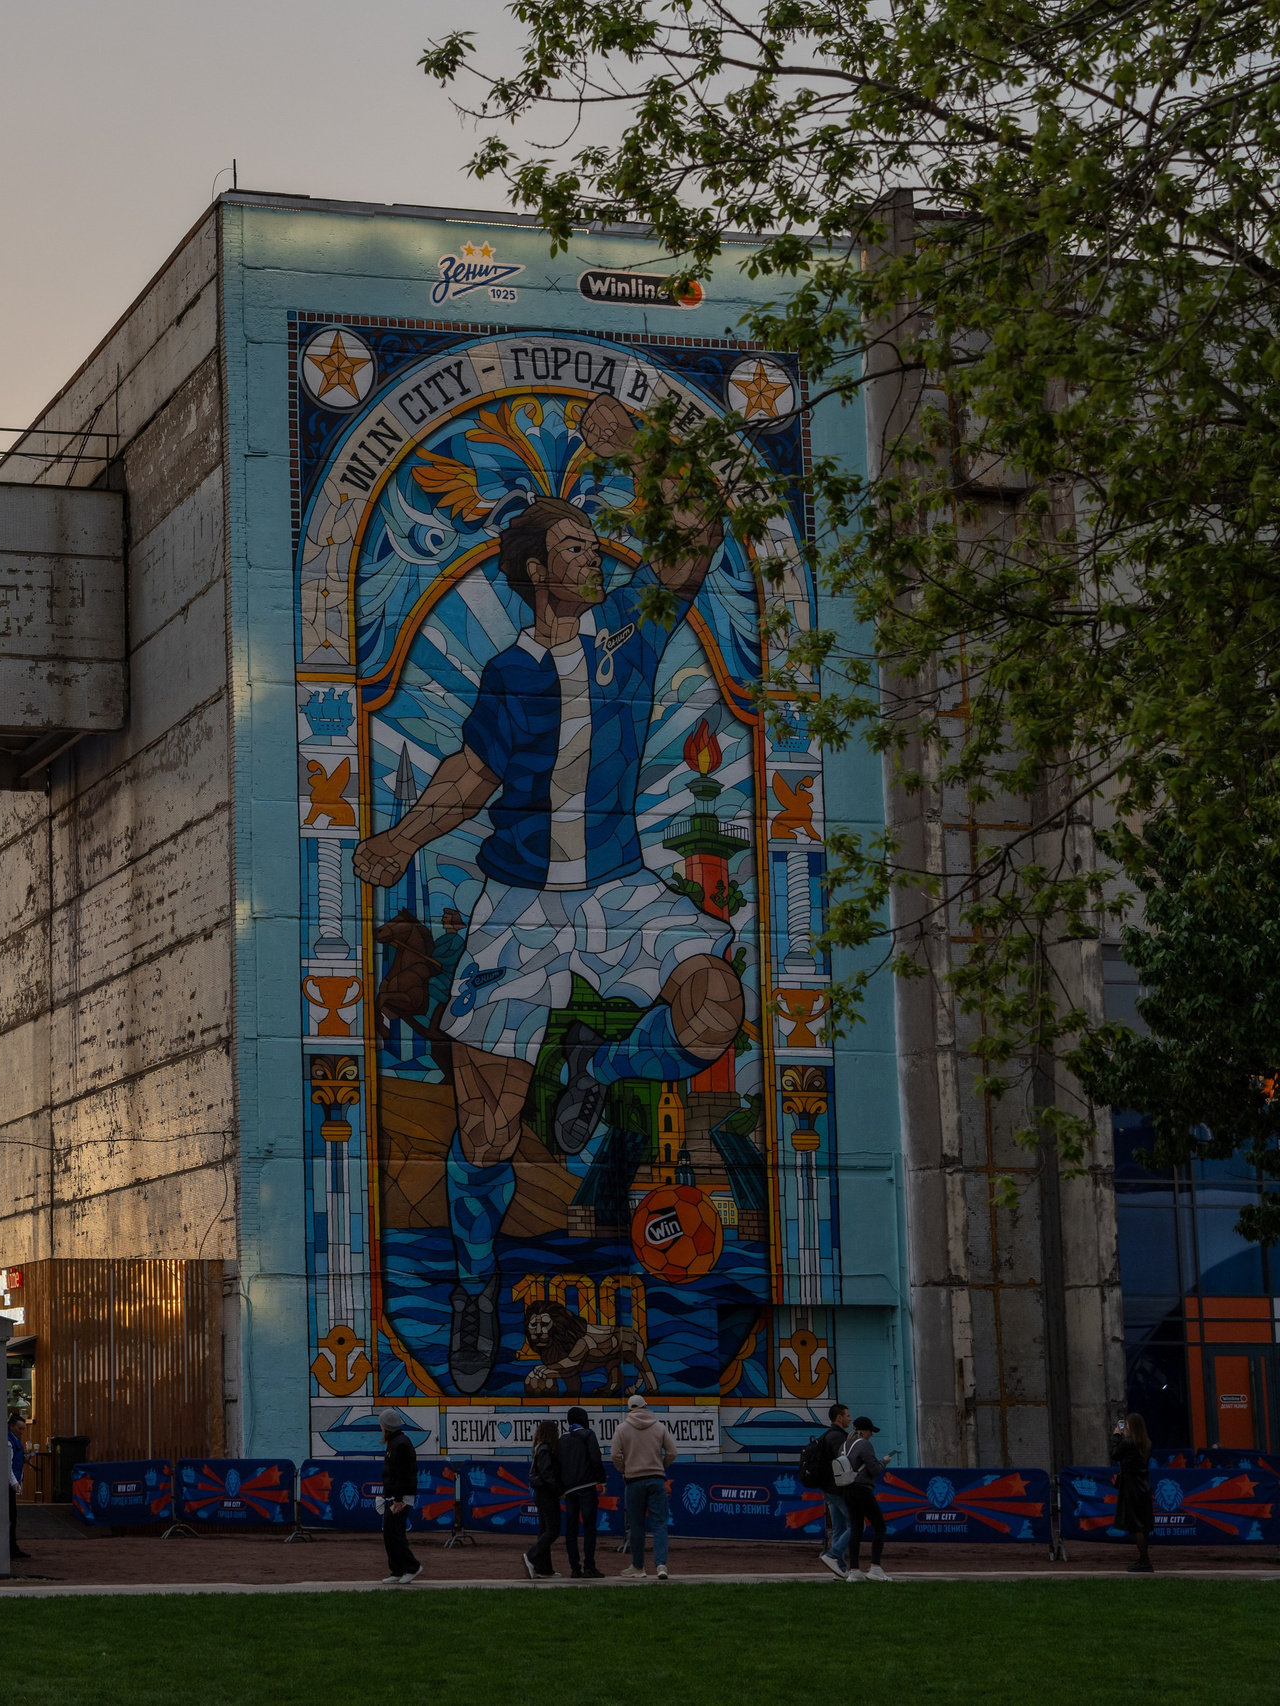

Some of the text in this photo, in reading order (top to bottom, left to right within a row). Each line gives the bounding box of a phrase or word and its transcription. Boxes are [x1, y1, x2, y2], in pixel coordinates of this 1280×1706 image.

[490, 288, 516, 301] 1925
[340, 416, 404, 493] WIN
[398, 359, 472, 425] CITY
[510, 346, 616, 394] ГОРОД
[626, 369, 648, 402] В
[649, 1218, 682, 1241] Win
[451, 1420, 498, 1442] ЗЕНИТ
[658, 1420, 715, 1441] МЕСТЕ
[721, 1489, 757, 1499] WIN CITY
[709, 1502, 770, 1515] ГОРОД В ЗЕНИТЕ
[925, 1513, 957, 1521] WIN CITY
[915, 1524, 968, 1534] ГОРОД В ЗЕНИТЕ
[1172, 1528, 1197, 1536] ЗЕНИТЕ
